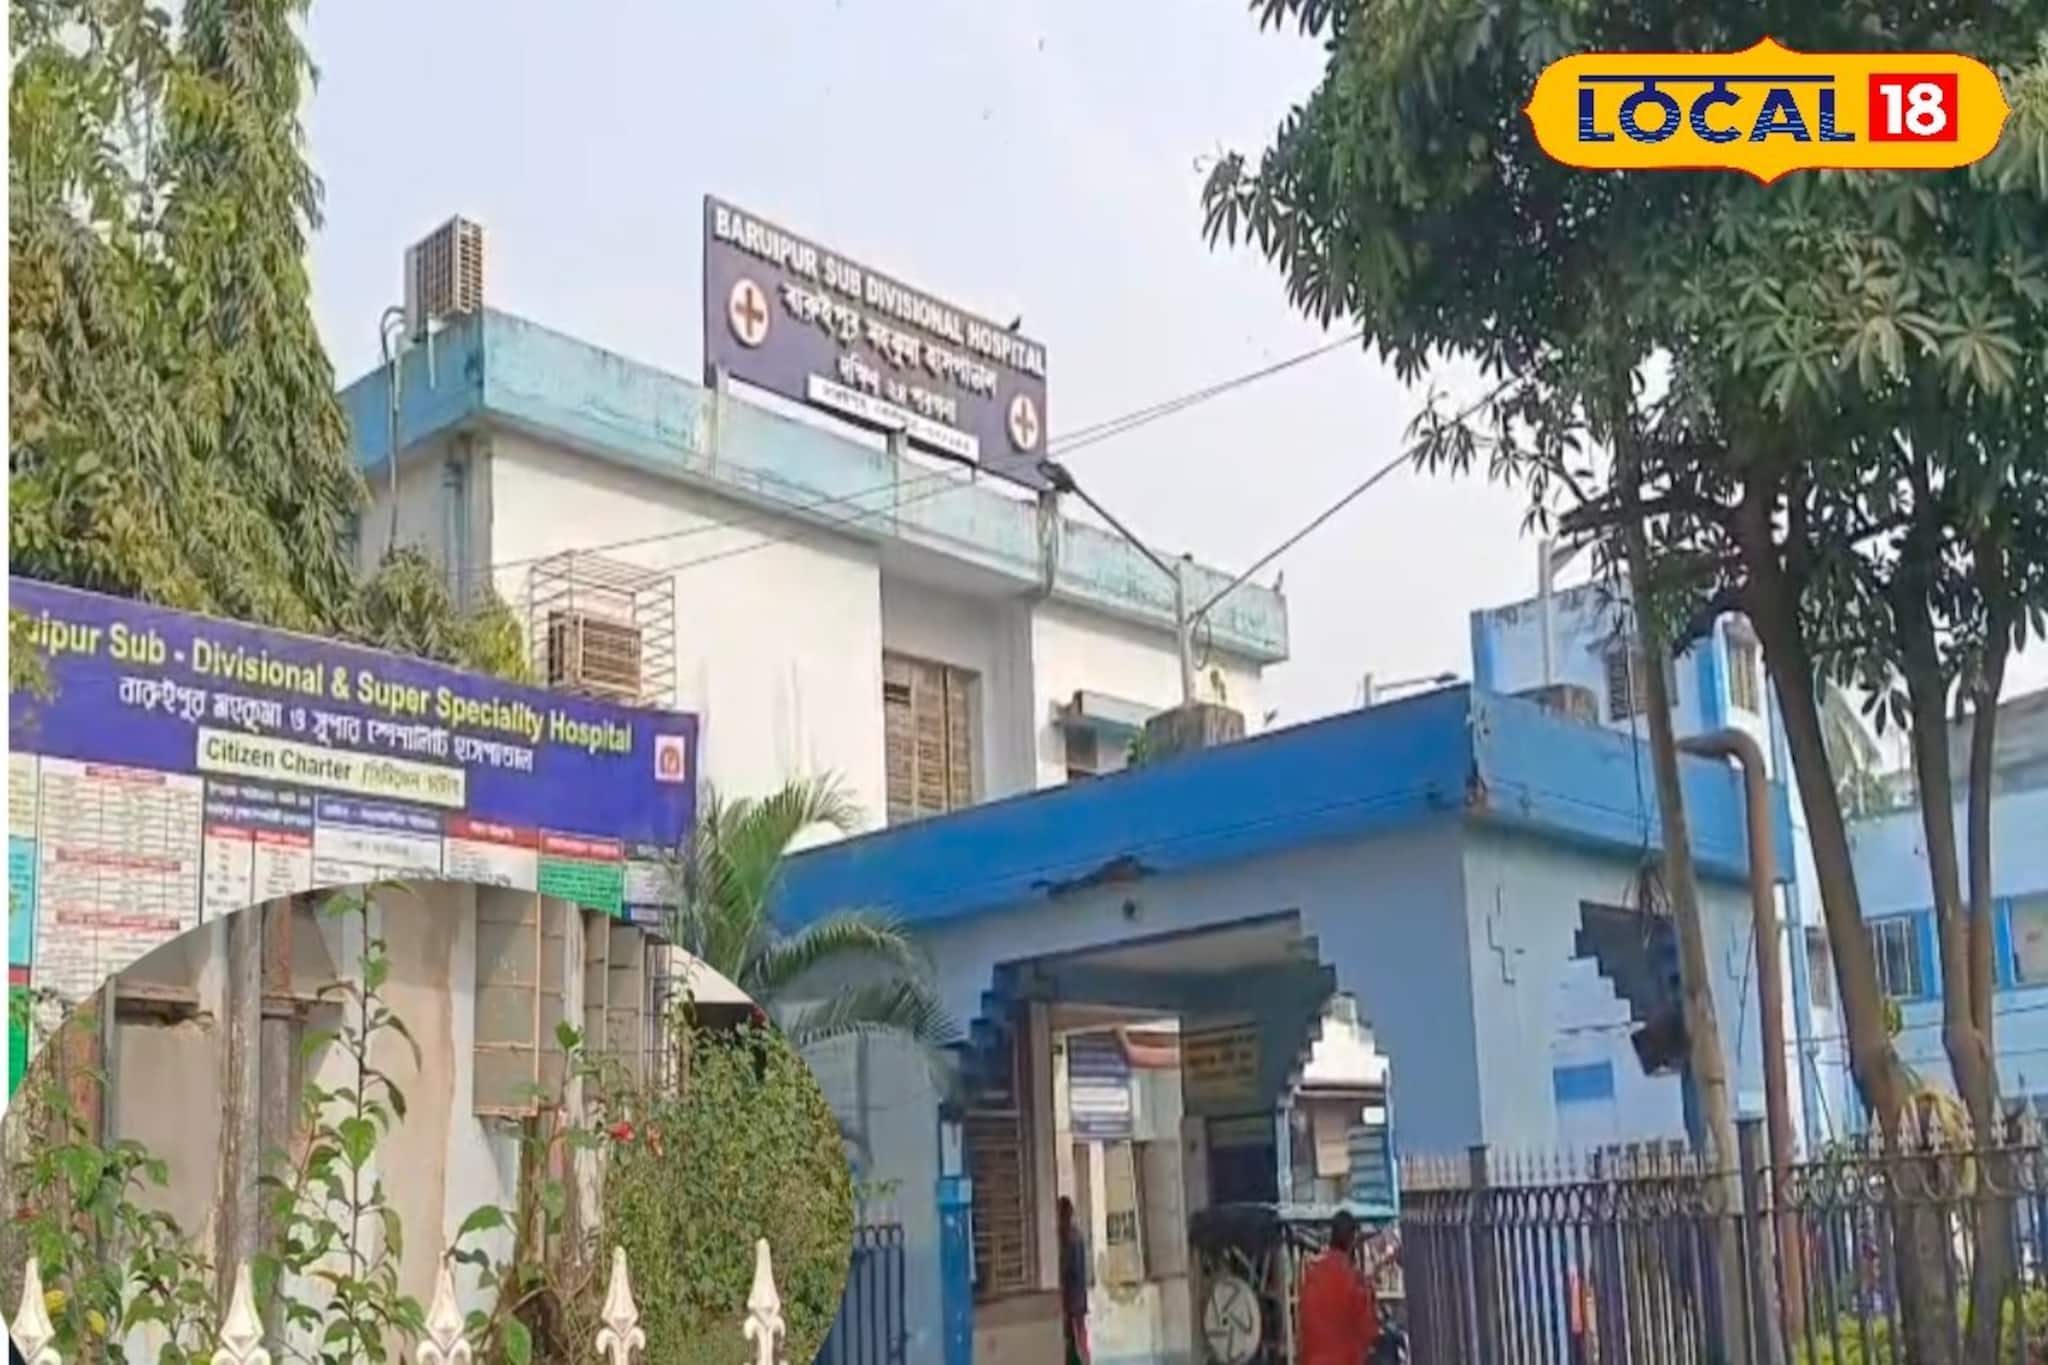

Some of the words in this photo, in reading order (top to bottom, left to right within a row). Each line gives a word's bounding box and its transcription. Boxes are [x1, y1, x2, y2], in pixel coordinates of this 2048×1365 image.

[715, 205, 818, 278] BARUIPUR
[825, 255, 861, 297] SUB
[866, 274, 964, 346] DIVISIONAL
[967, 320, 1044, 377] HOSPITAL
[109, 621, 166, 665] Sub
[192, 637, 323, 698] Divisional
[331, 666, 350, 700] &
[357, 671, 430, 717] Super
[435, 686, 544, 743] Speciality
[550, 708, 632, 754] Hospital
[119, 676, 207, 723] বারুইপুর
[289, 708, 306, 732] ও
[206, 737, 275, 770] Citizen
[280, 747, 351, 782] Charter
